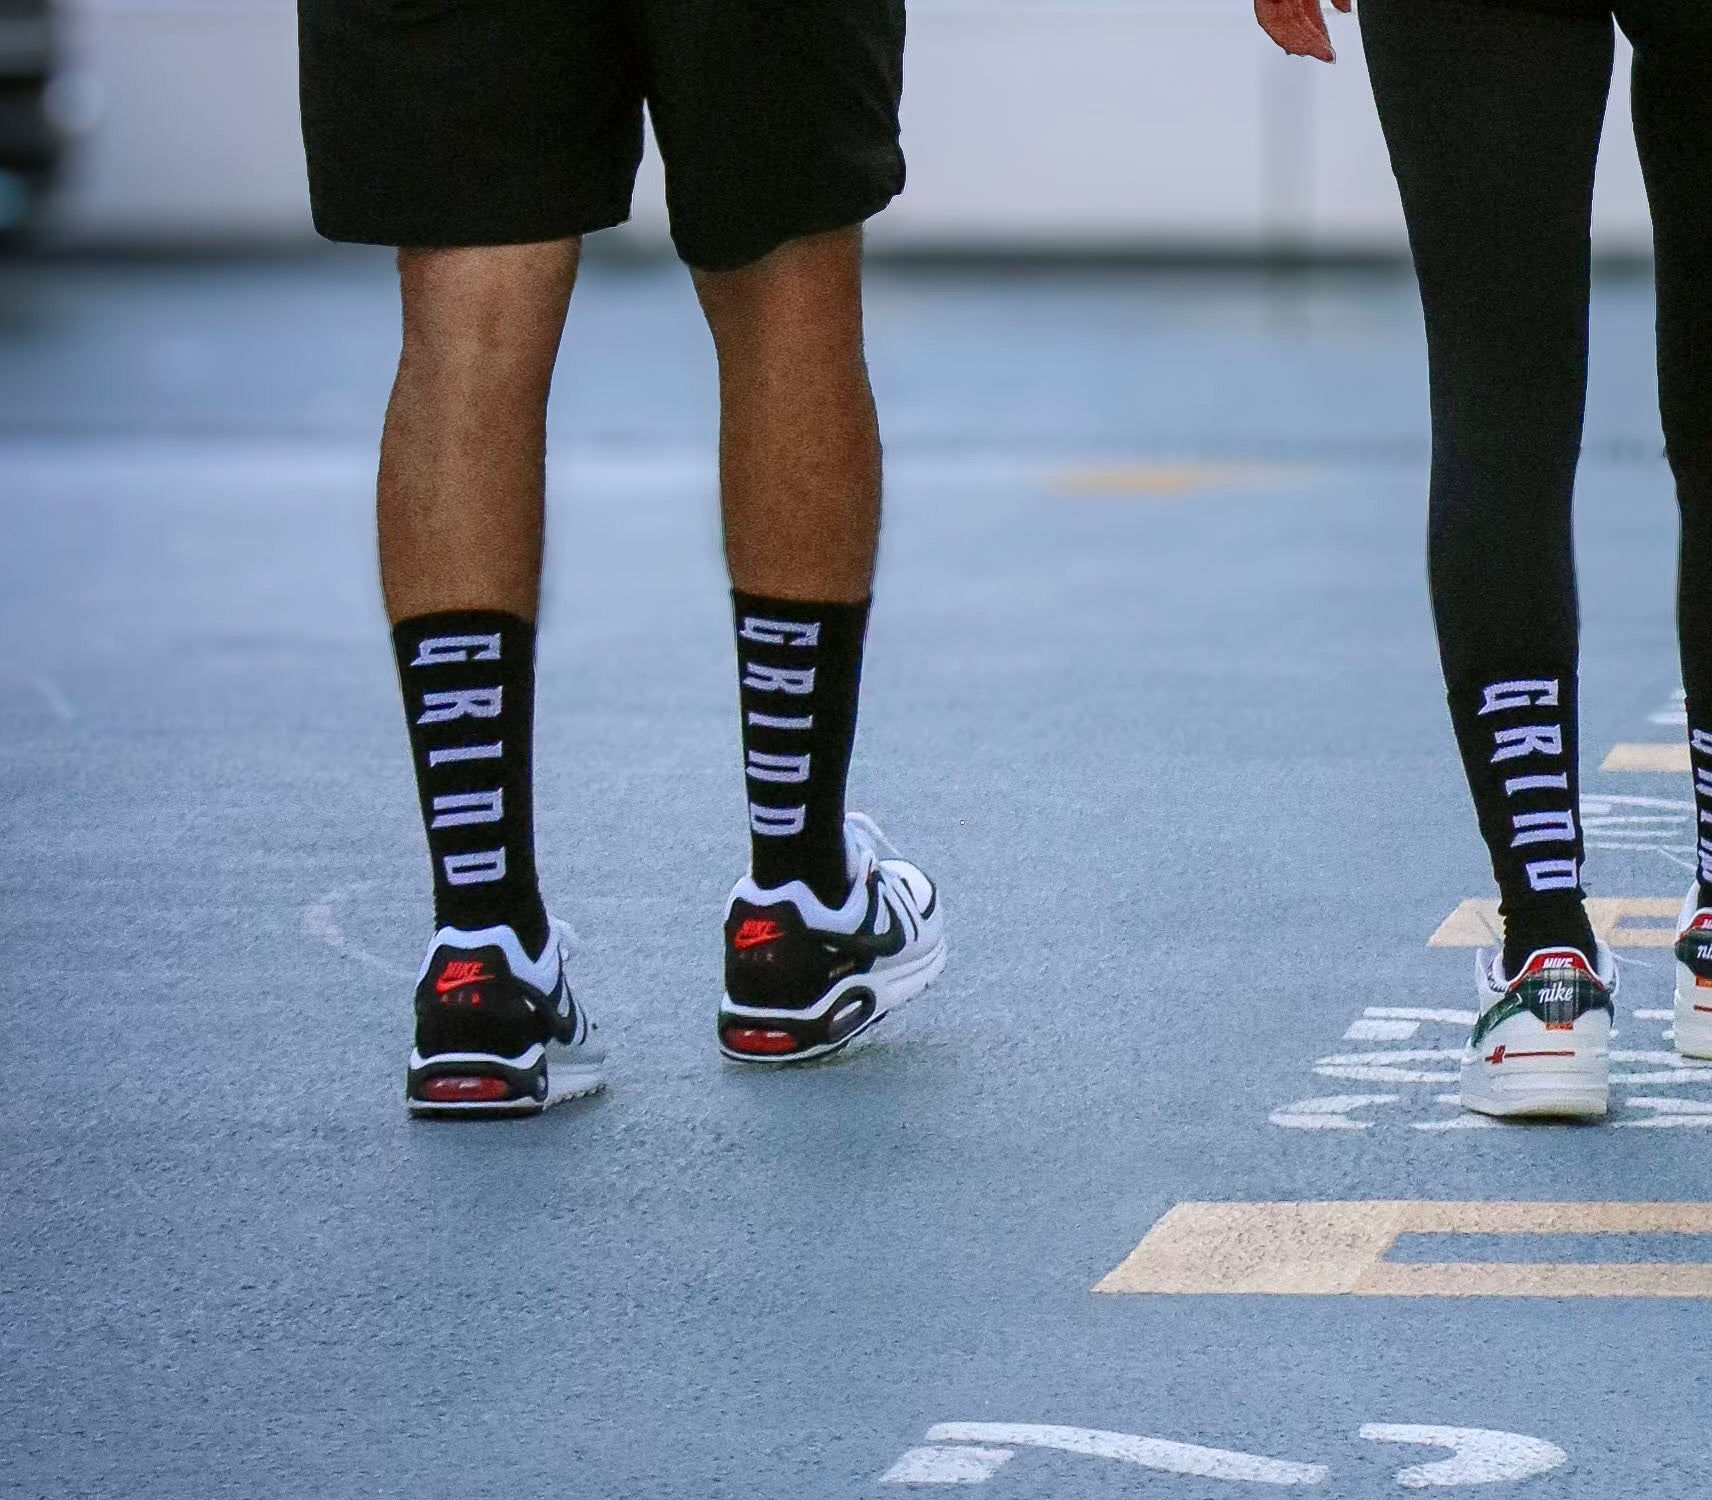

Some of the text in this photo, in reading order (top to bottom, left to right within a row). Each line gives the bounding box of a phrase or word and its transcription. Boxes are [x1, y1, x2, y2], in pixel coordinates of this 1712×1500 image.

[410, 632, 506, 887] GRIND
[738, 617, 821, 837] GRIND
[1477, 678, 1579, 892] GRIND
[440, 961, 484, 980] NIKE
[1538, 980, 1575, 1004] nike
